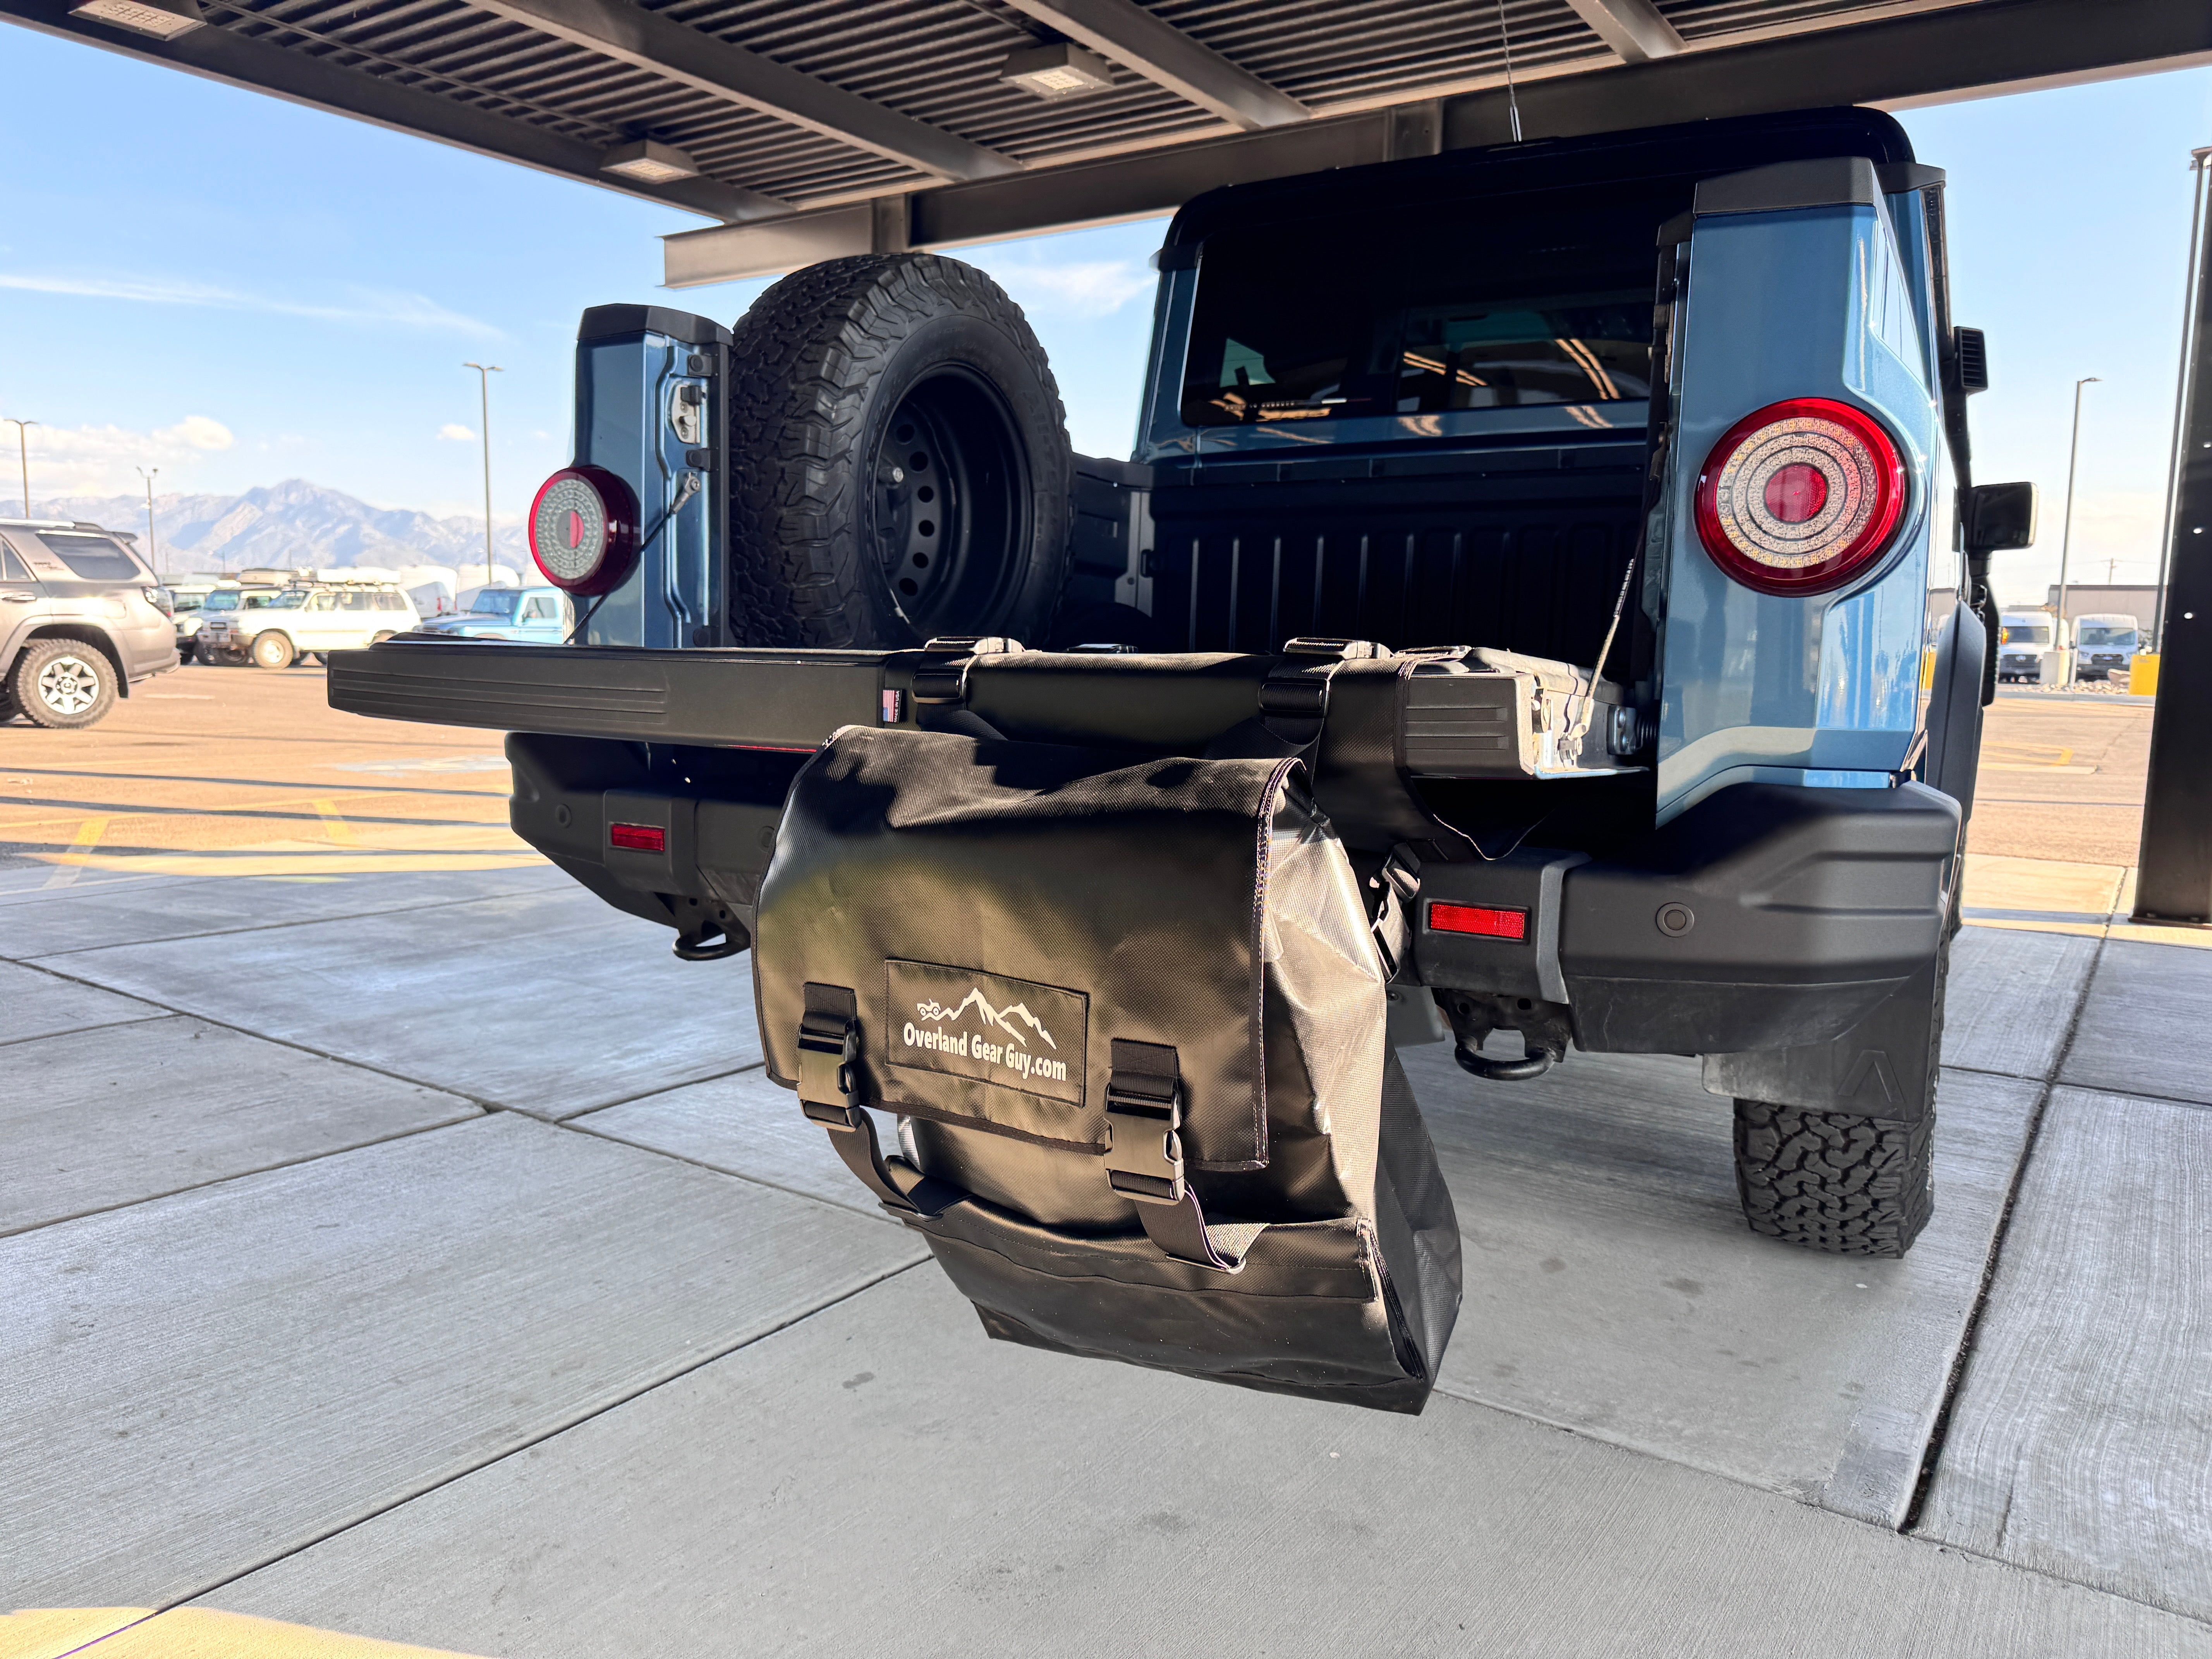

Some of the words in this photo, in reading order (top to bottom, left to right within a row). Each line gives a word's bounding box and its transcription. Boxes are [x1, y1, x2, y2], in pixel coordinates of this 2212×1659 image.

[903, 1022, 967, 1056] Overland
[971, 1034, 1003, 1064] Gear
[1005, 1043, 1066, 1081] Guy.com
